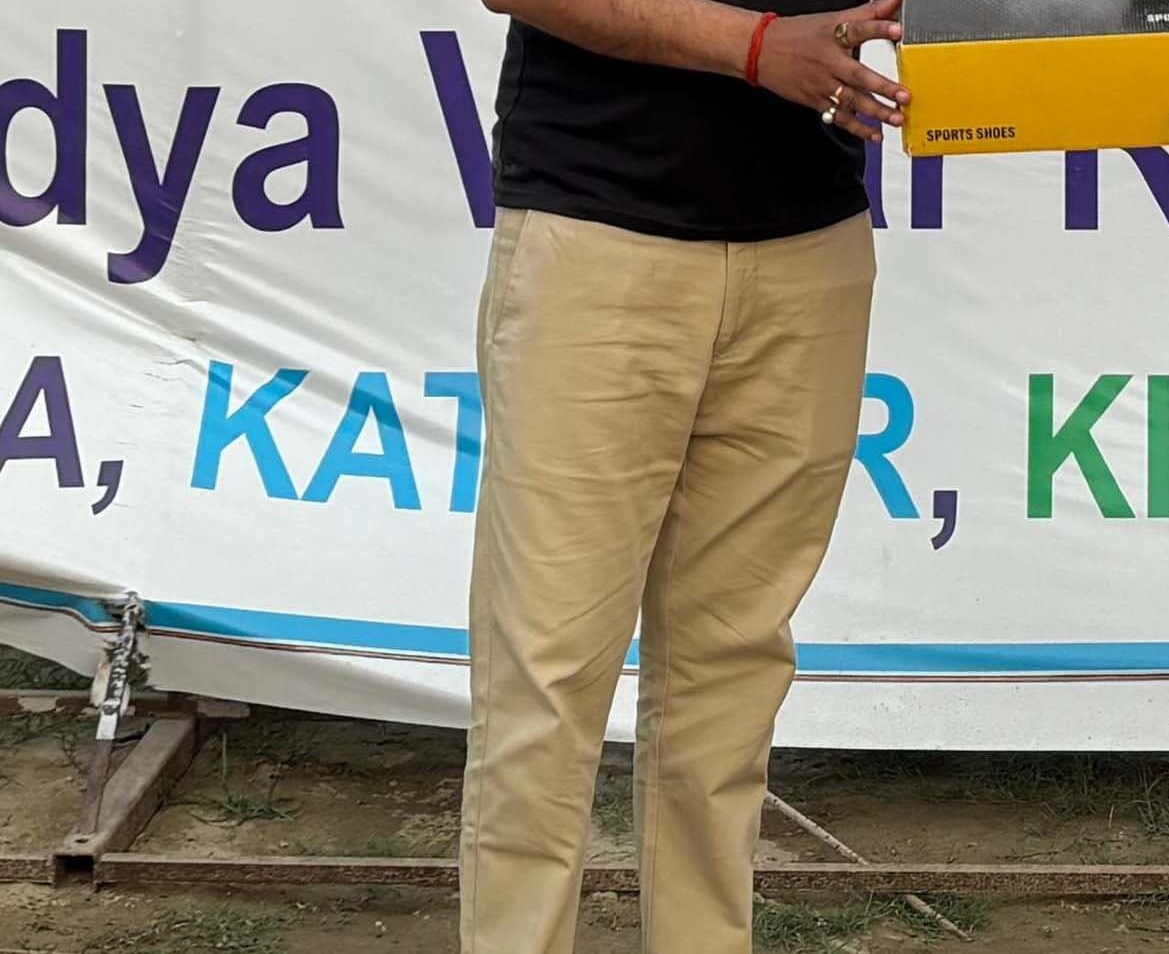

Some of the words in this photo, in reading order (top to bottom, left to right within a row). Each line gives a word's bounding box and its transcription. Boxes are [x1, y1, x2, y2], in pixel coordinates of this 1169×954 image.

[926, 128, 973, 142] SPORTS
[976, 126, 1016, 140] SHOES
[190, 359, 958, 551] KATR,
